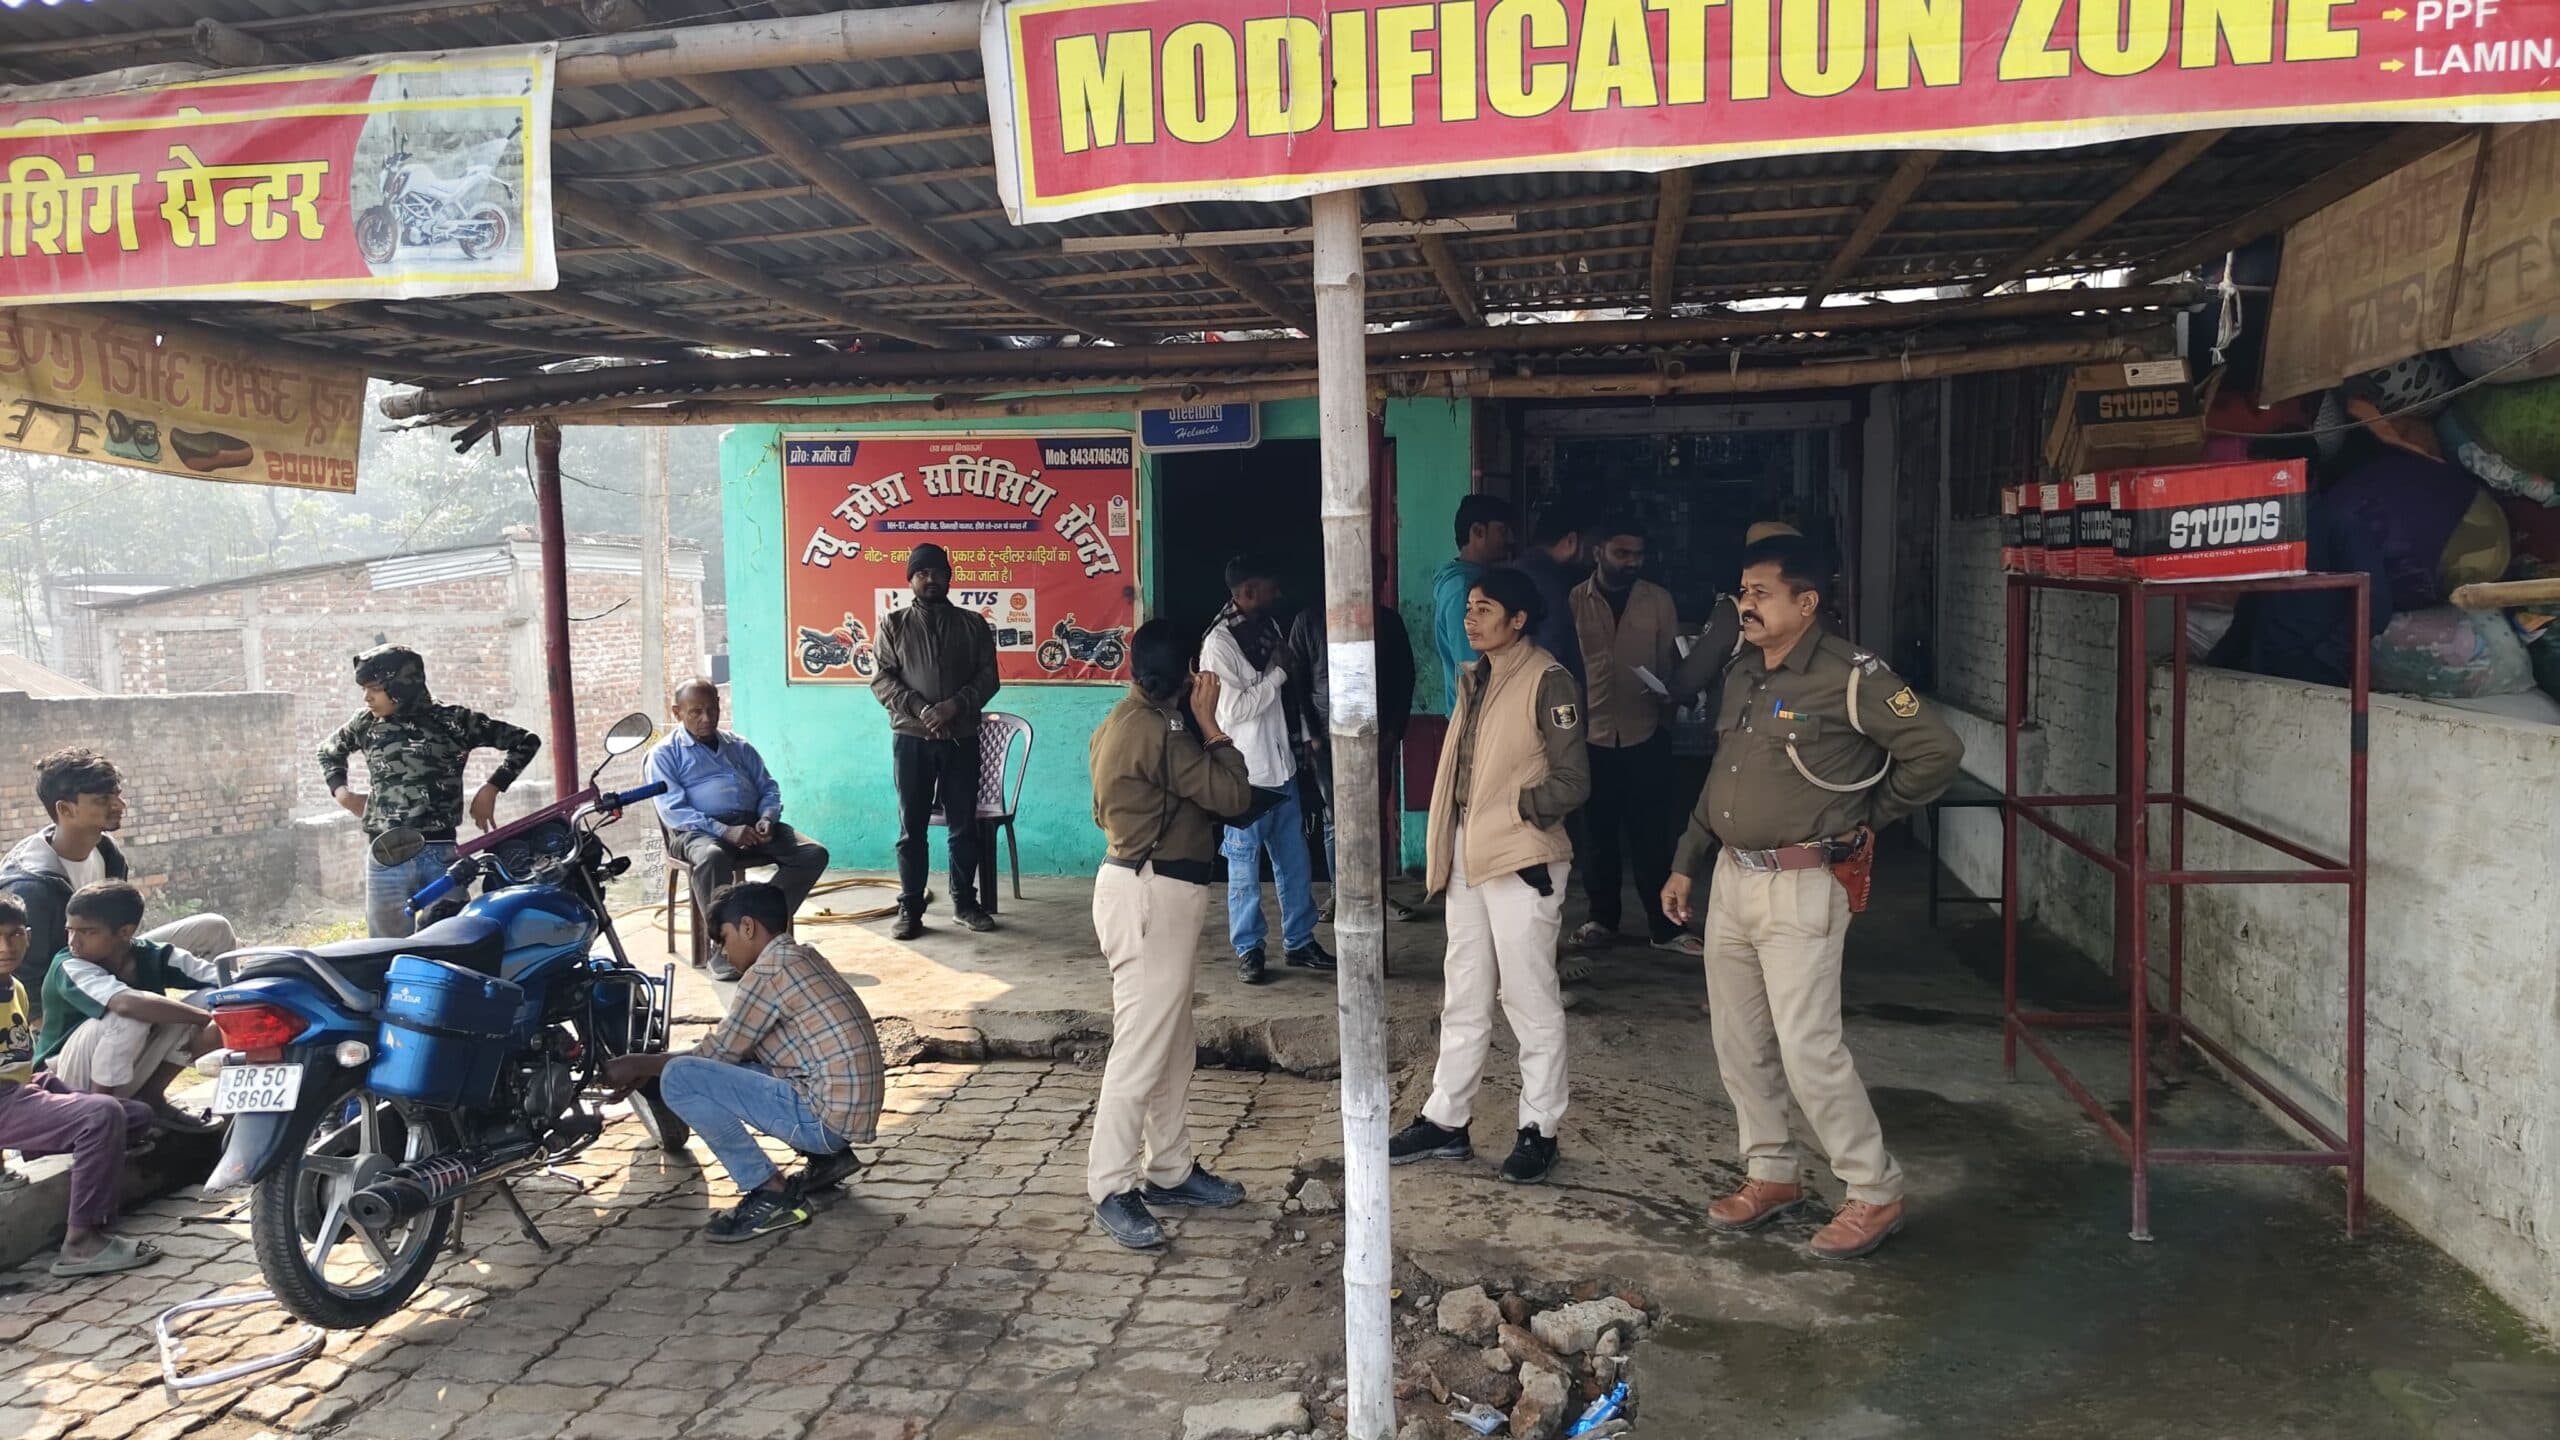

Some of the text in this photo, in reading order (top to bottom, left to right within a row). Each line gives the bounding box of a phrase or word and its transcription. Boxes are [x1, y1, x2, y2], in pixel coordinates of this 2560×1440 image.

[2416, 0, 2499, 32] PPF
[2414, 38, 2560, 77] LAMIN
[1054, 0, 2359, 155] MODIFICATION ZONE
[157, 144, 329, 247] सेन्टर
[2099, 391, 2179, 418] STUDDS
[1175, 425, 1219, 439] Helmets
[1045, 448, 1129, 465] Mob: 8434746426
[831, 472, 912, 531] उमेश
[2169, 500, 2280, 548] STUDDS
[802, 526, 861, 567] न्यू
[1054, 503, 1120, 577] सेन्टर
[2183, 550, 2235, 560] PROTECTION
[2238, 544, 2293, 555] TECHNOLOGY
[951, 550, 975, 564] प्रकार
[976, 547, 985, 561] के
[1058, 550, 1070, 562] का
[955, 566, 976, 581] किया
[978, 570, 1000, 581] जाता
[960, 591, 999, 605] TVS
[233, 1067, 287, 1087] BR 50
[226, 1088, 286, 1109] S8604
